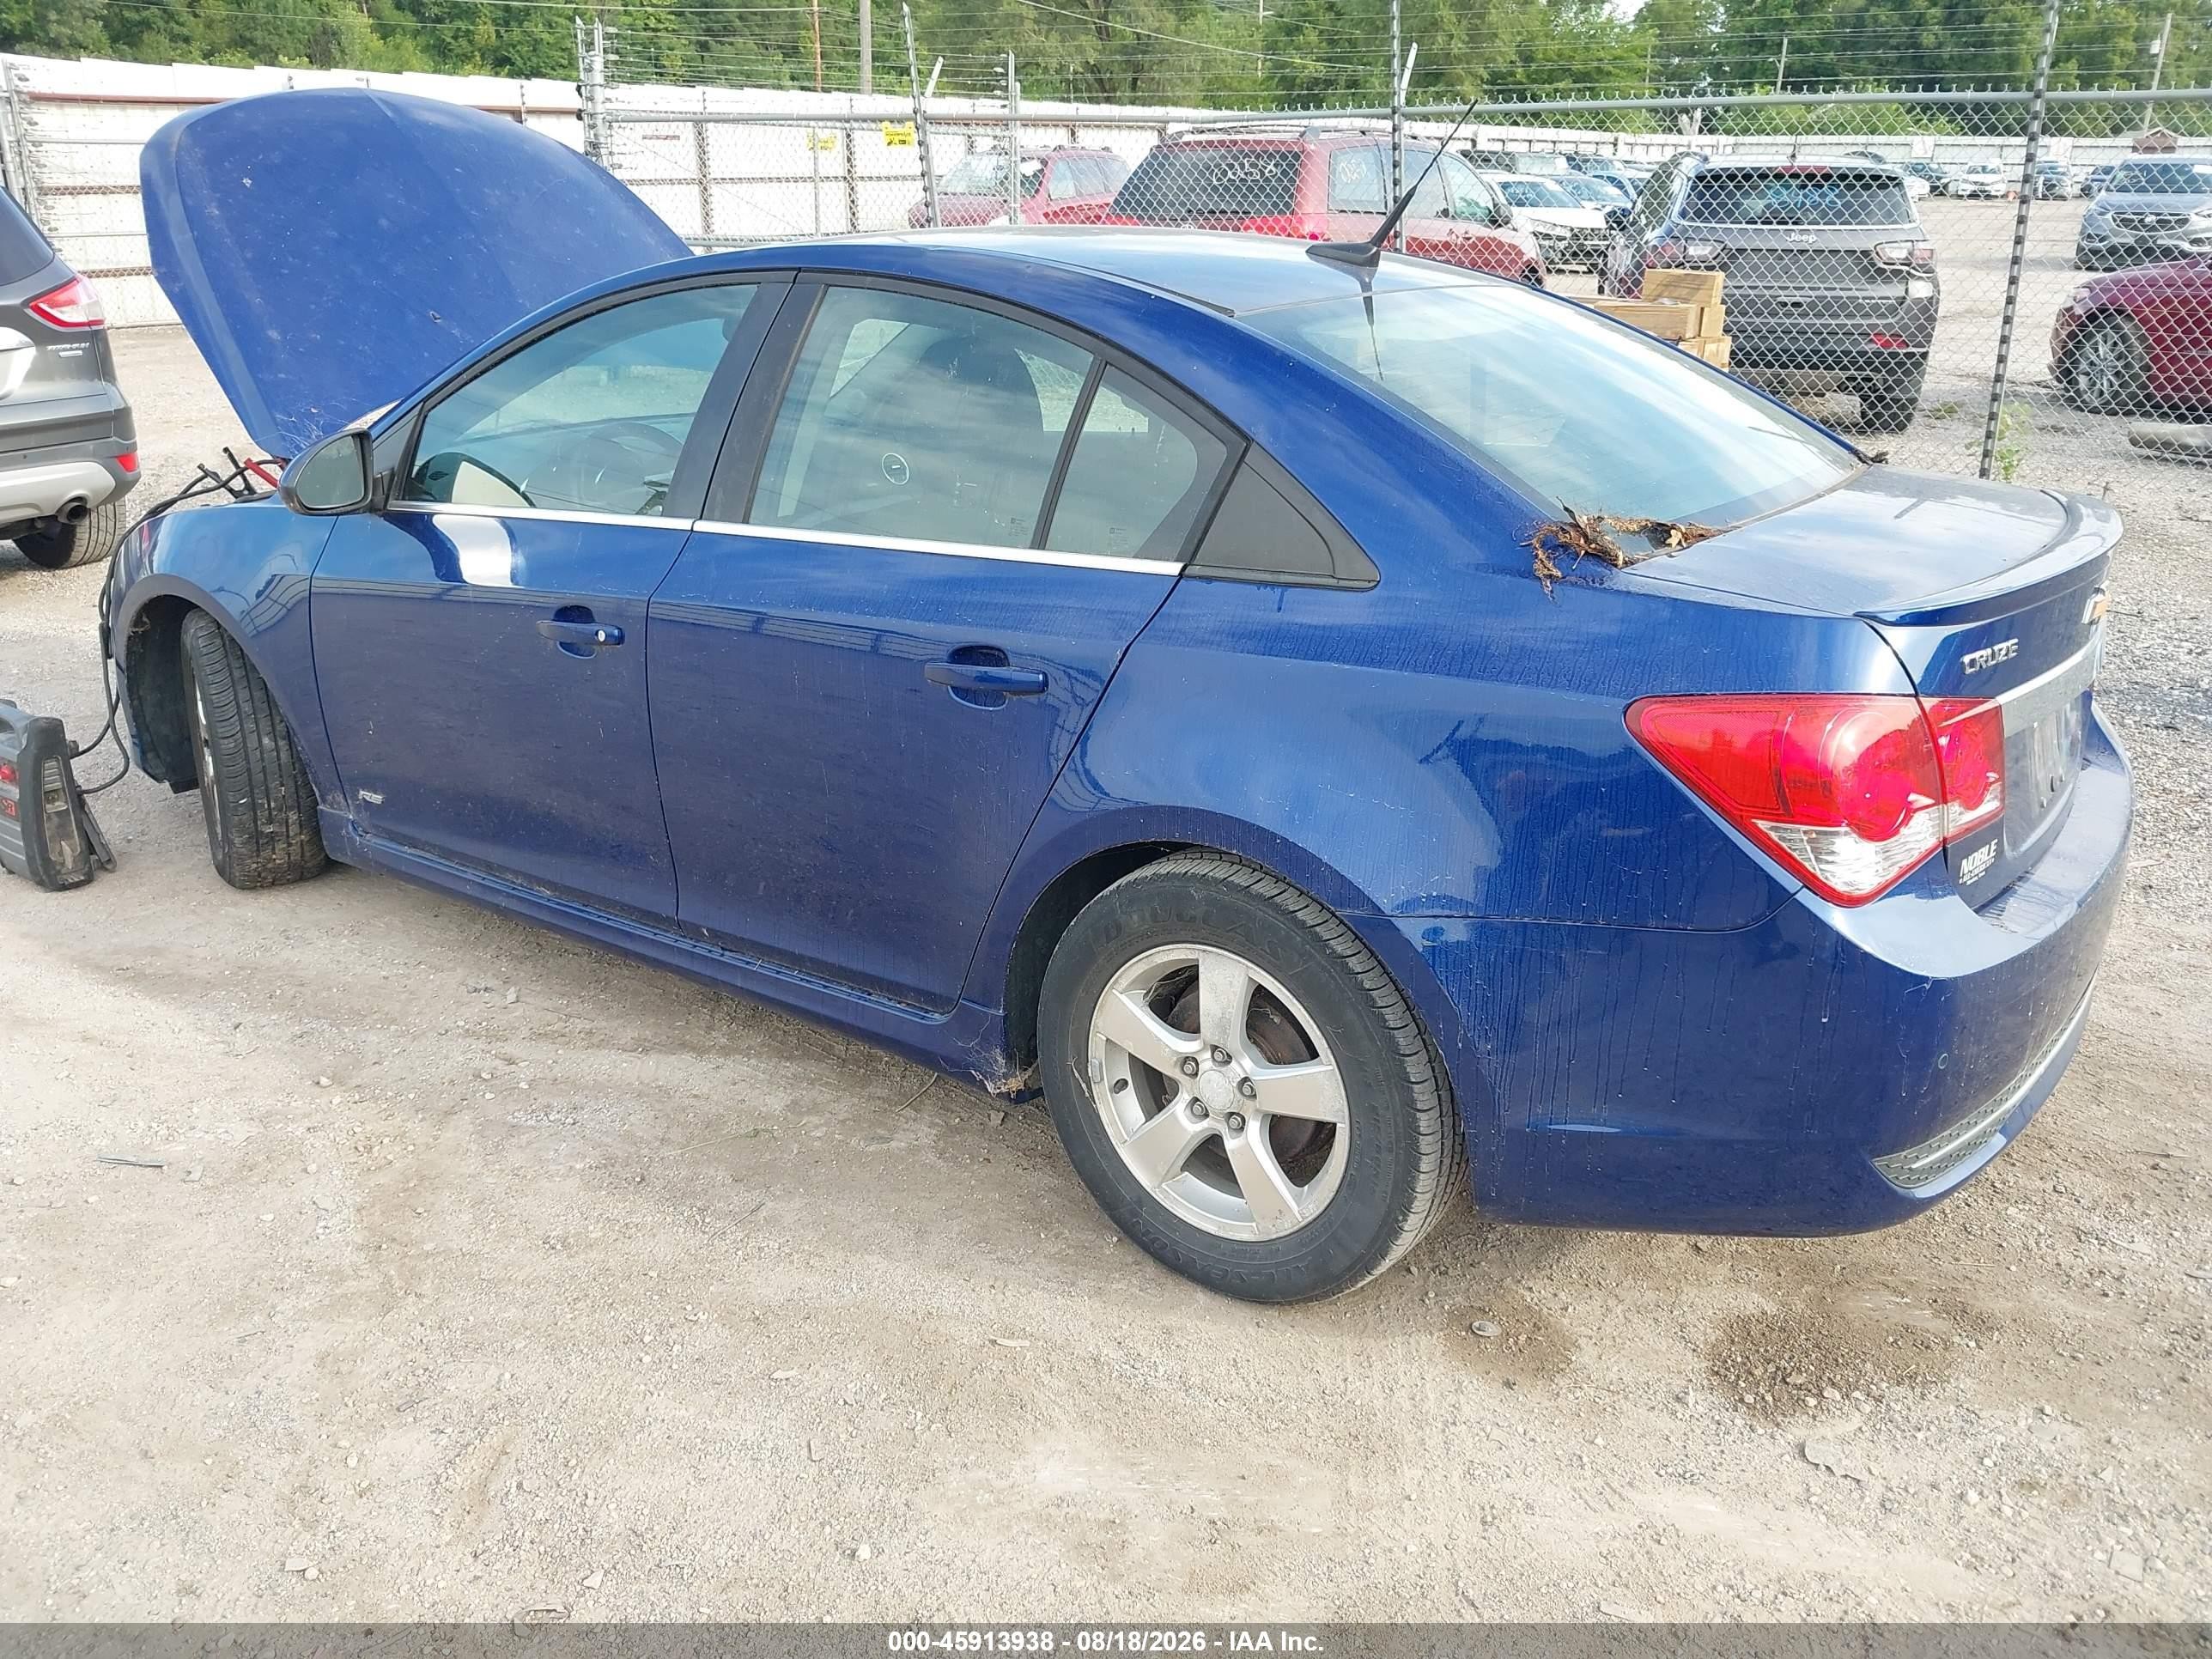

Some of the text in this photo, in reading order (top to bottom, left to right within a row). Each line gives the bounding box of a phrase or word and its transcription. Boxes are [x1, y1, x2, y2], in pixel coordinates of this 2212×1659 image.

[1787, 233, 1817, 245] Jeep
[1960, 638, 2019, 675] CRUZE
[1959, 838, 1998, 878] NOBLE
